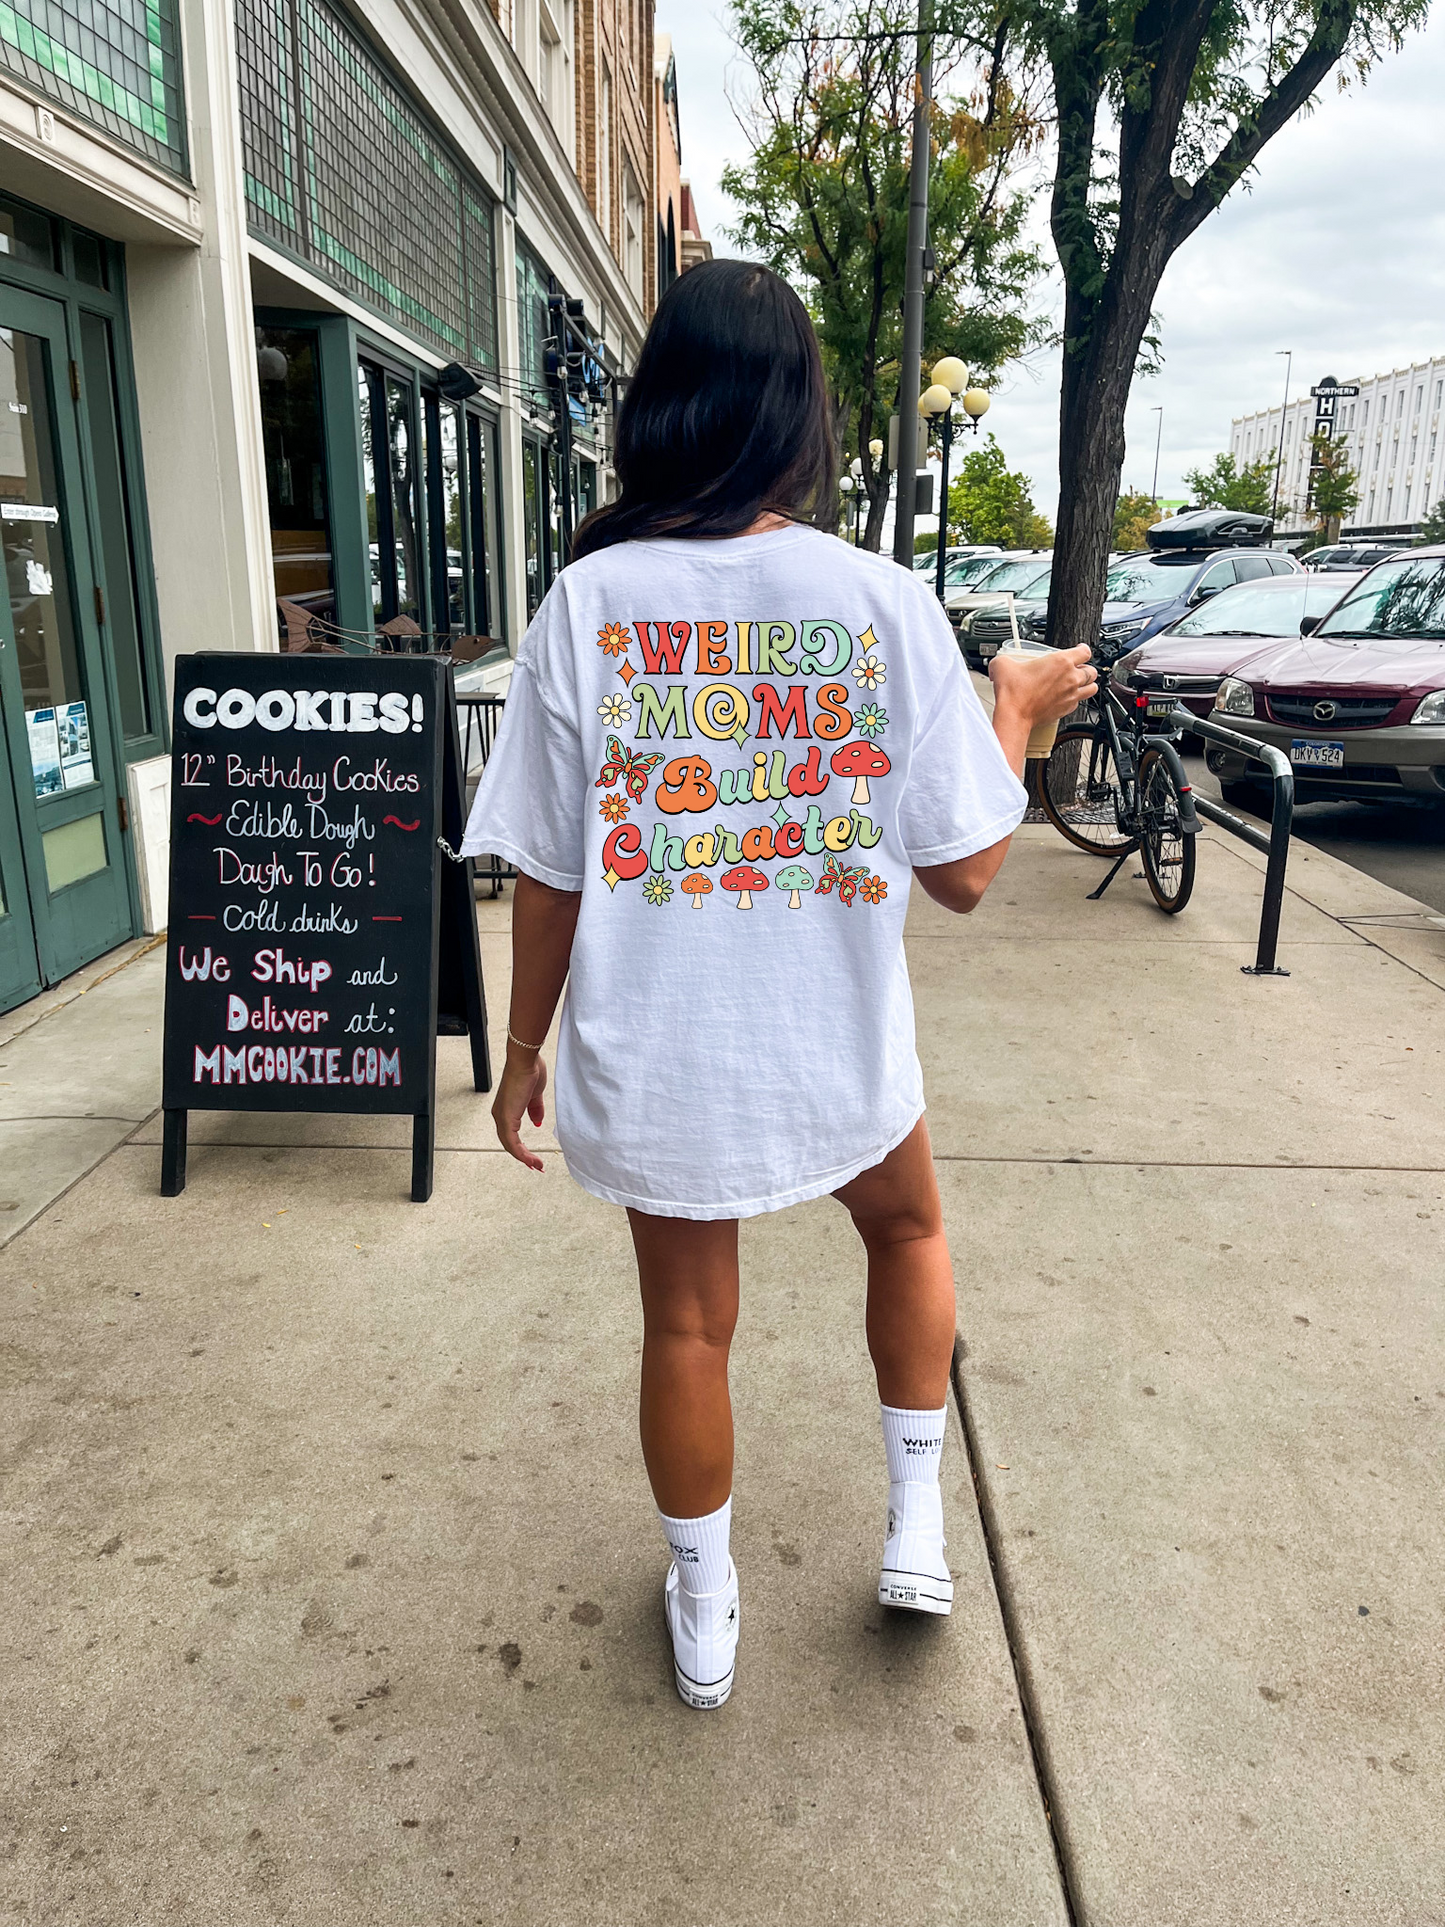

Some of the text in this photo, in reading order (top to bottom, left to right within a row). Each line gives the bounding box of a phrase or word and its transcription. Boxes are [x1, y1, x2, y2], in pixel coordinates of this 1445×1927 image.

[1314, 387, 1356, 396] NORTHERN
[632, 619, 853, 677] WEIRD
[183, 687, 424, 734] COOKIES!
[632, 683, 853, 740] MOMS
[227, 754, 327, 804] Birthday
[1321, 748, 1340, 763] 524
[655, 746, 830, 814] Build
[226, 800, 375, 850] Edible Dough
[602, 805, 883, 881] Character
[213, 847, 293, 893] Dough
[296, 851, 322, 887] To
[223, 899, 286, 933] Cold
[179, 945, 398, 992] We Ship and
[226, 994, 329, 1033] Deliver
[193, 1044, 401, 1086] MMCOOKIE.COM
[678, 1554, 699, 1563] CLUB
